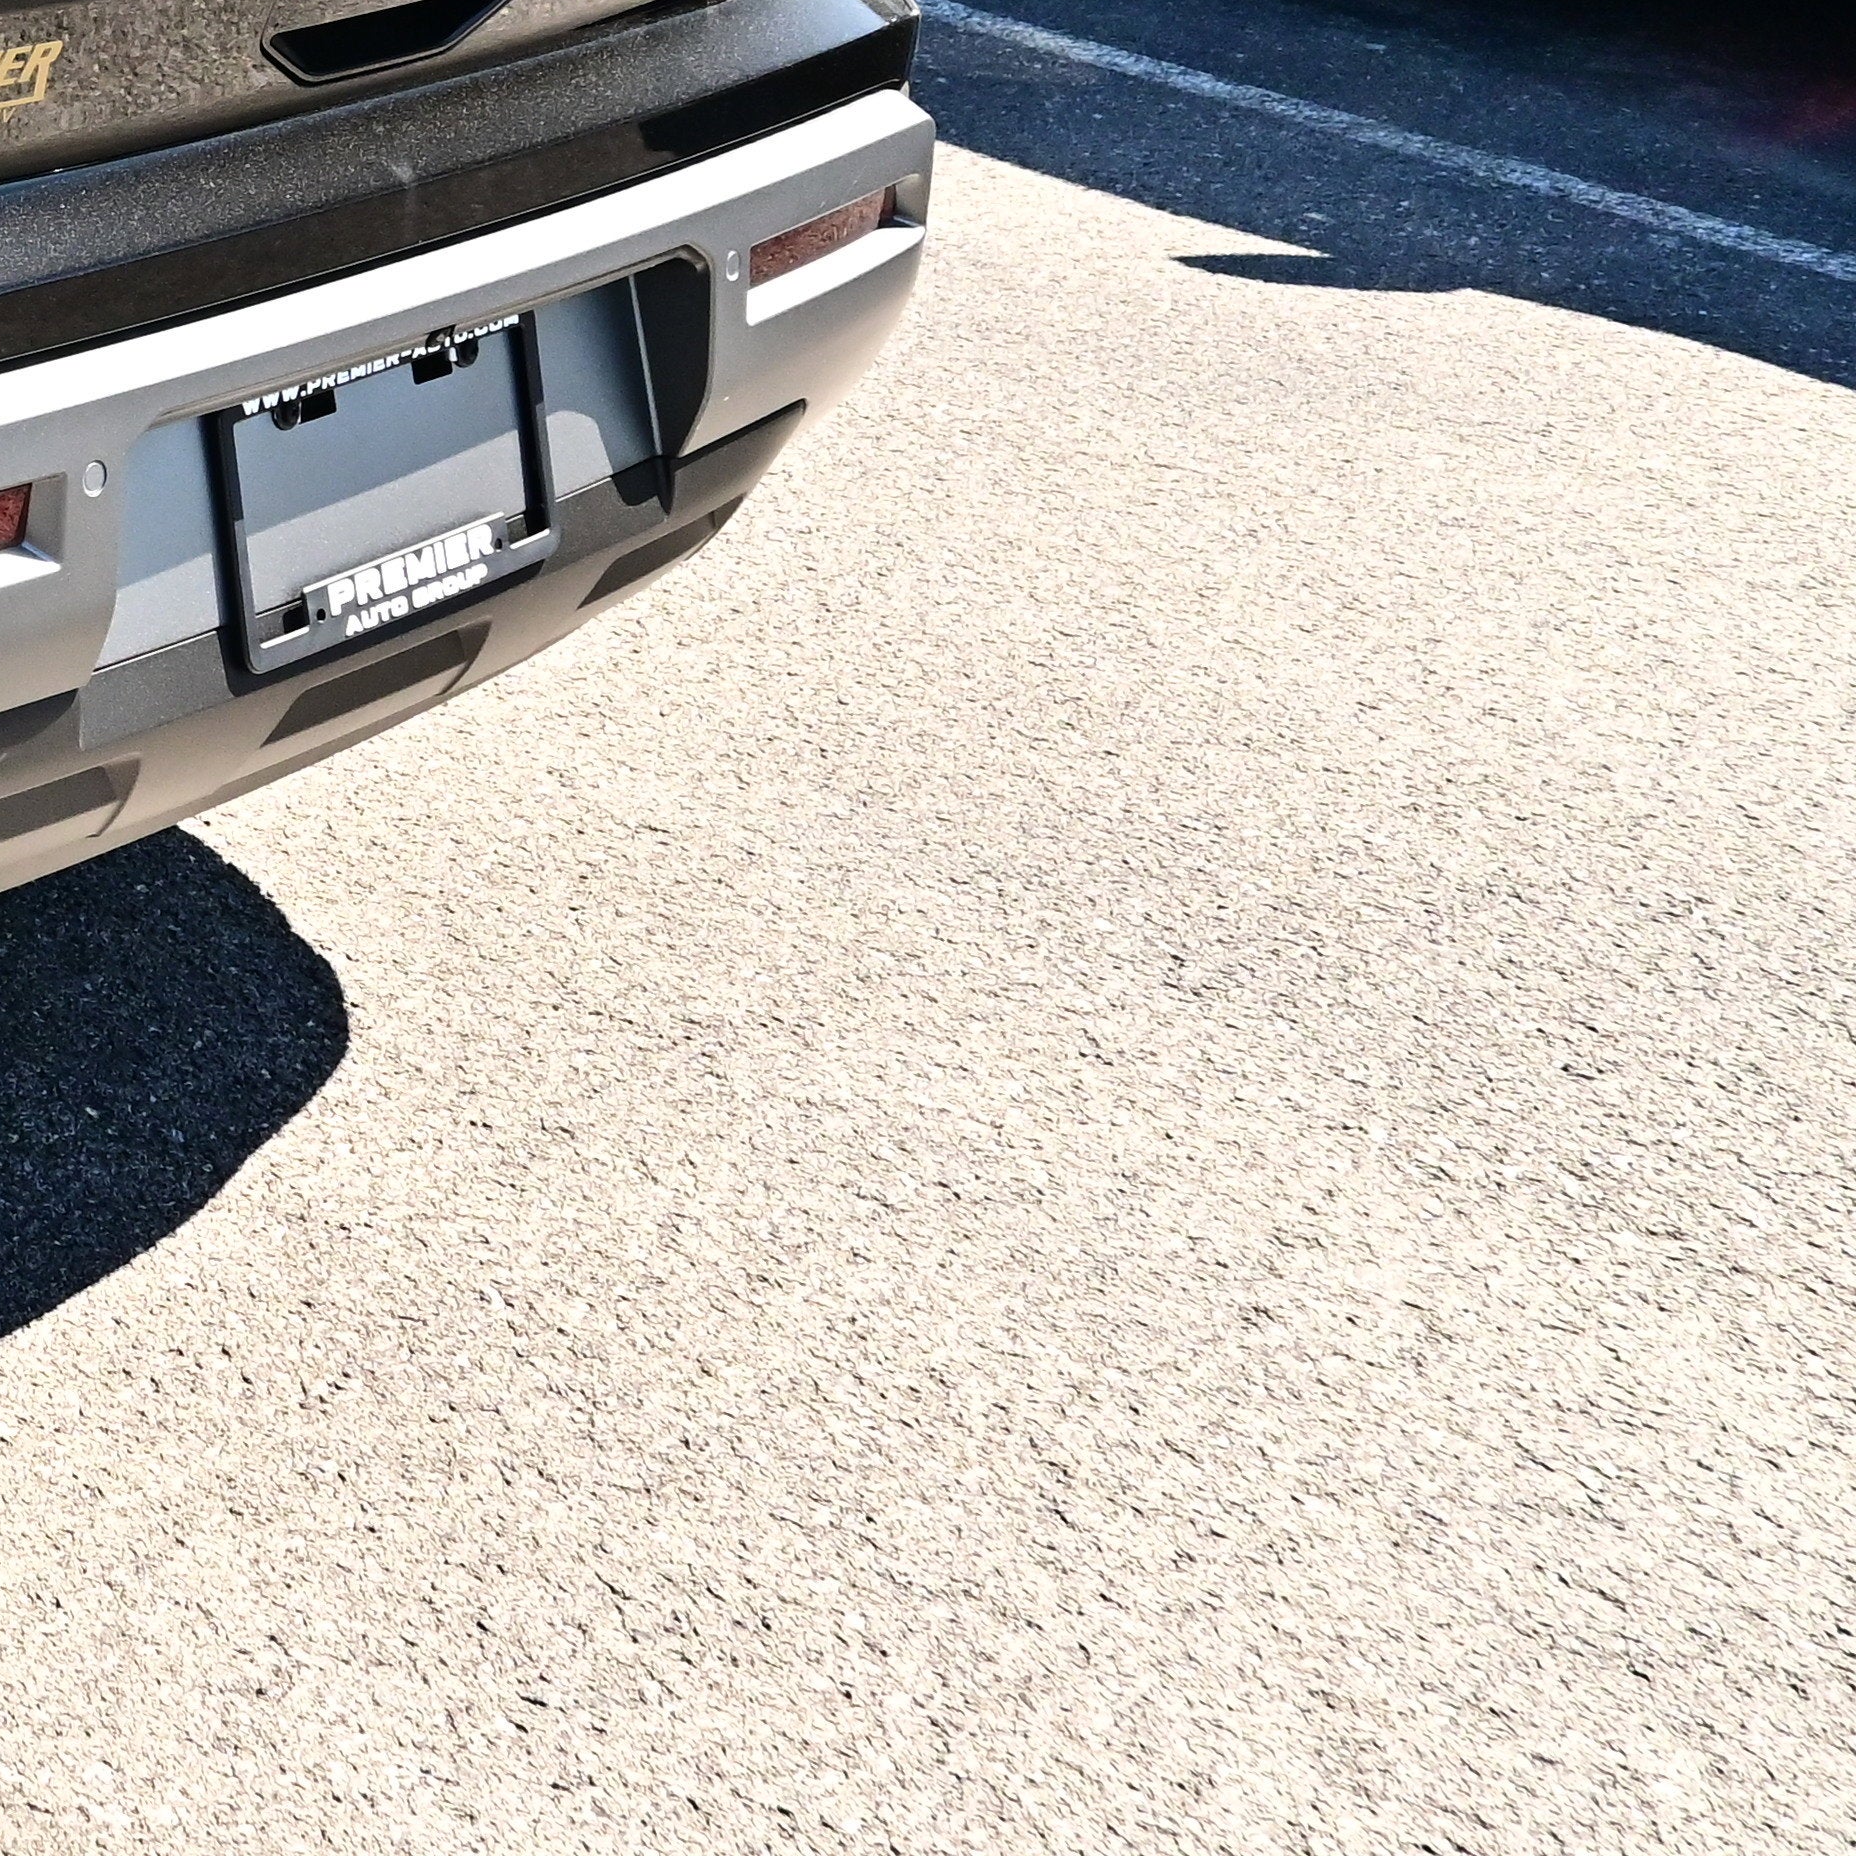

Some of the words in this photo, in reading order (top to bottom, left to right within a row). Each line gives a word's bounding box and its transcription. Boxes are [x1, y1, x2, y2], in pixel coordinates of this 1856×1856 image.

[327, 523, 495, 617] PREMIER
[345, 595, 409, 637] AUTO
[412, 563, 488, 609] GROUP
